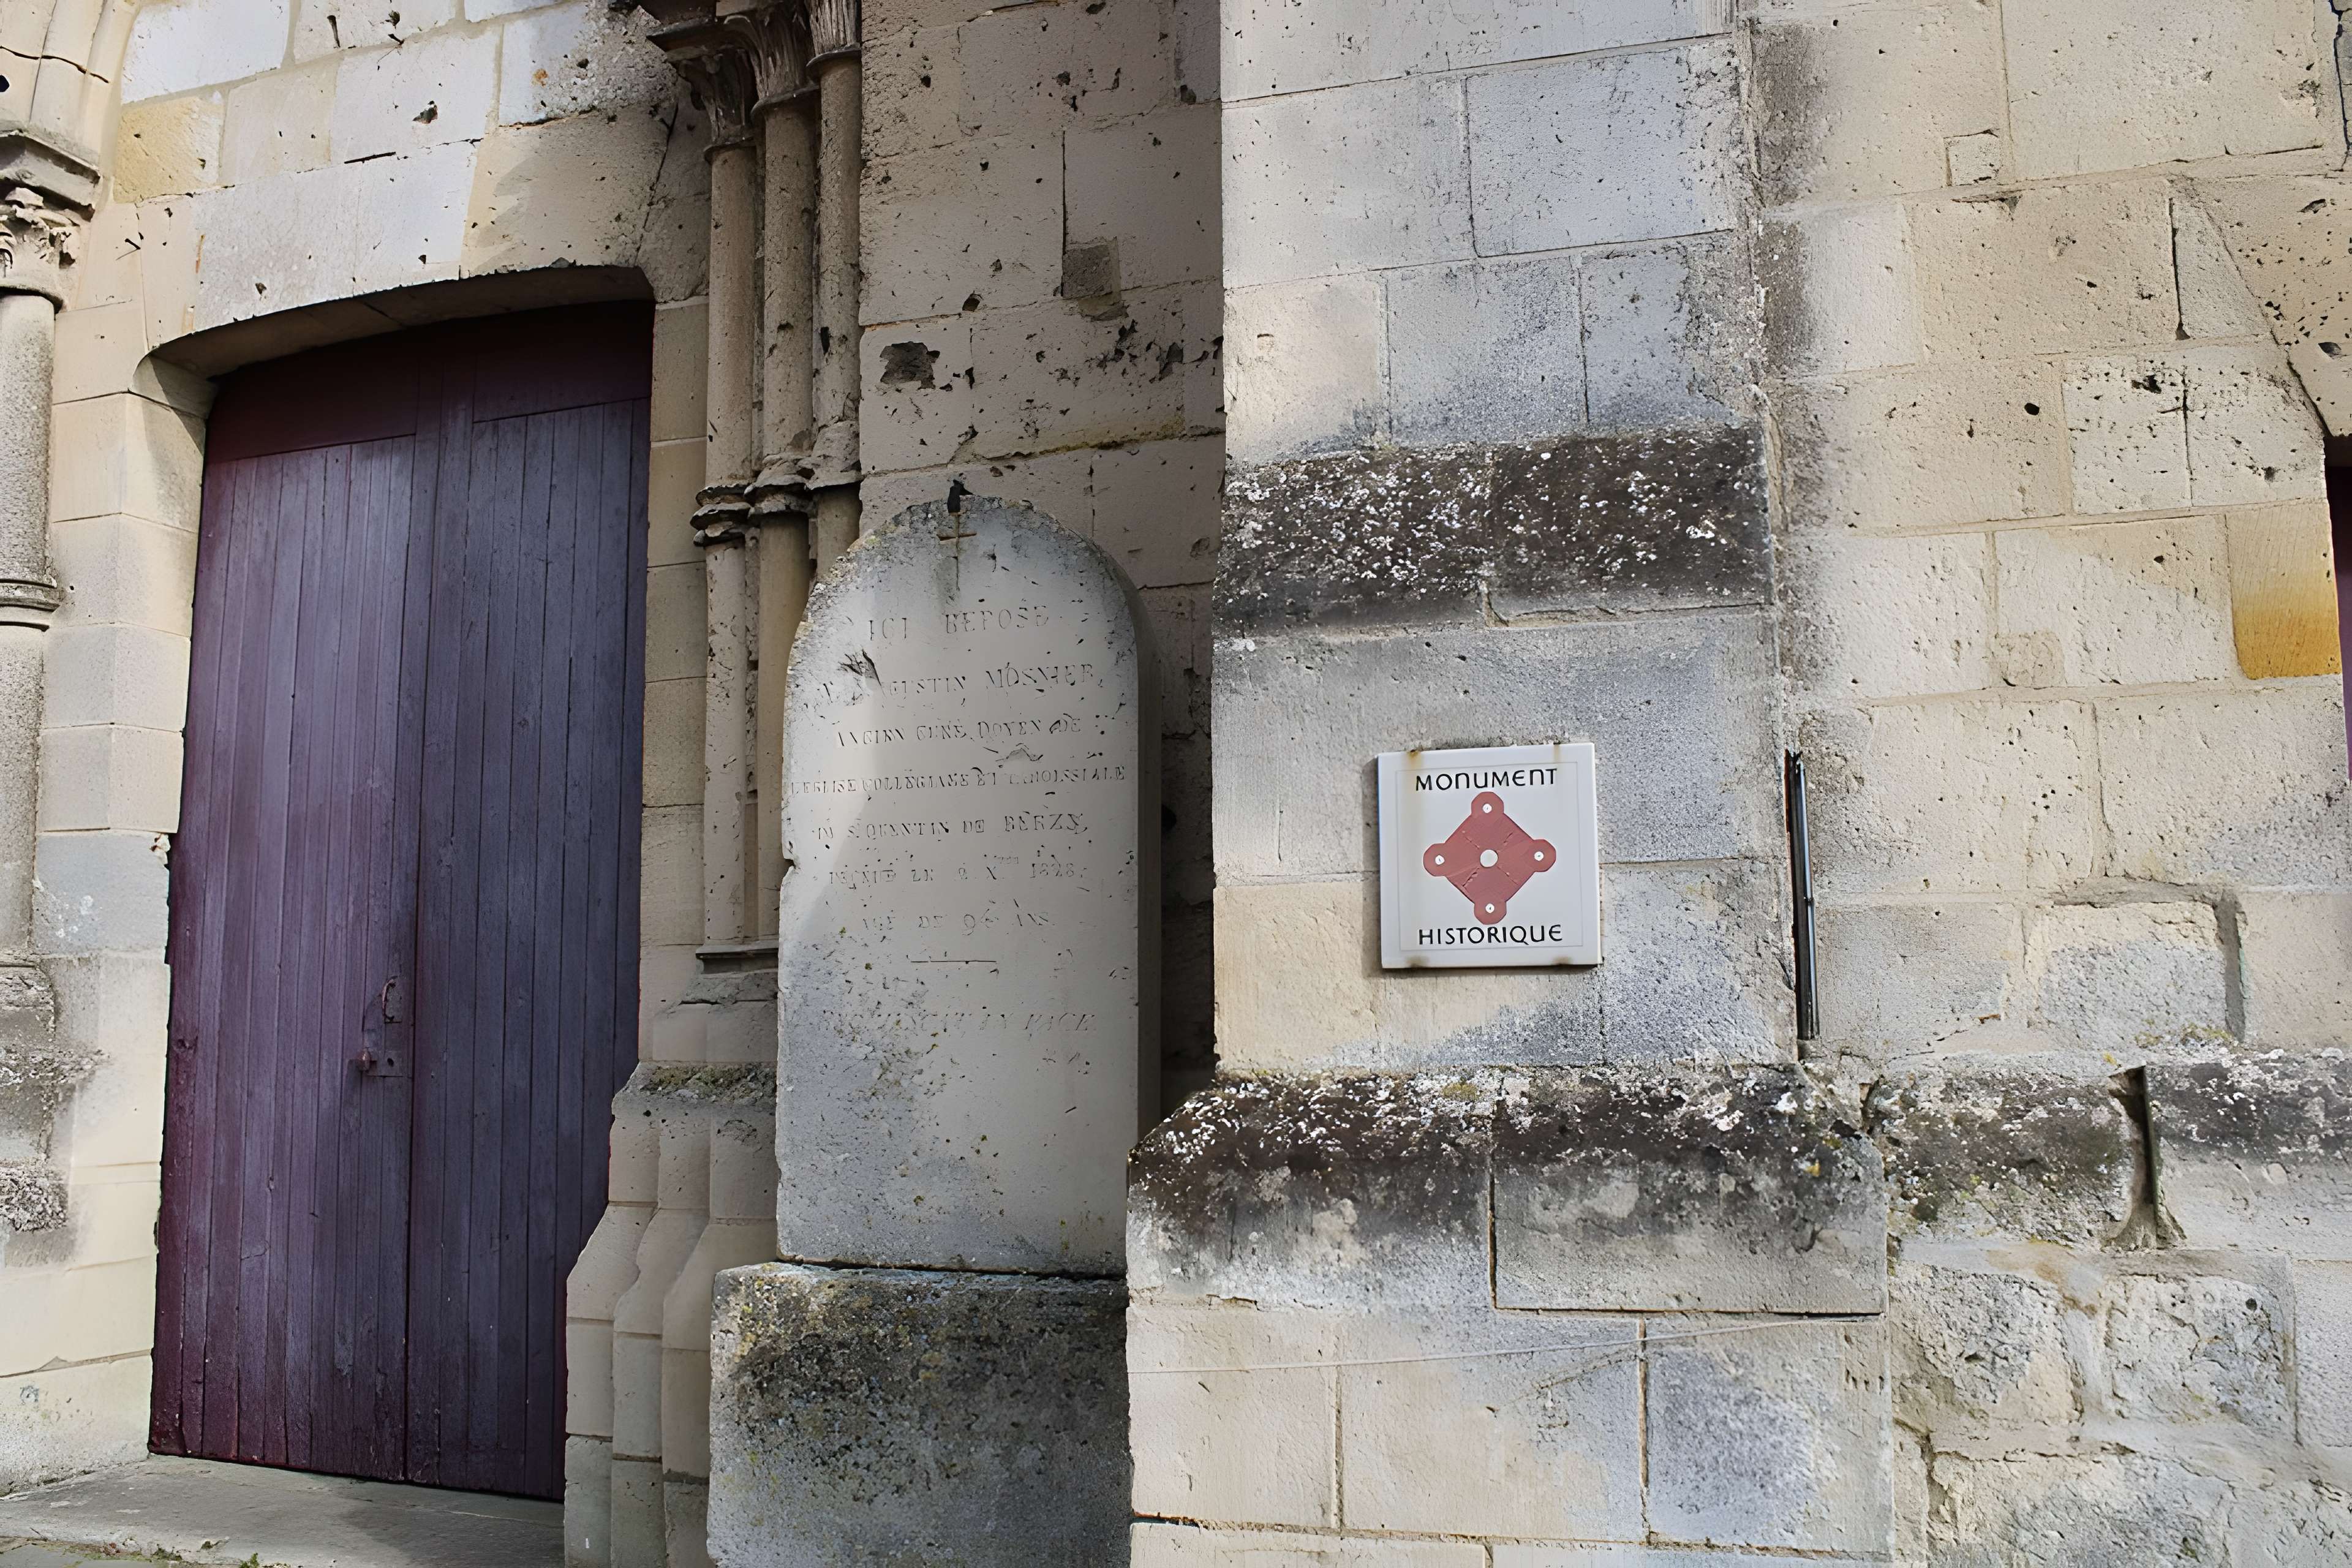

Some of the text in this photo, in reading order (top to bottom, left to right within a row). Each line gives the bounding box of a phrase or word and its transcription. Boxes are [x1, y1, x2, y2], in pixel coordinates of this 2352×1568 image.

[868, 616, 908, 641] ICI
[1415, 767, 1558, 791] MONUMENT
[1418, 924, 1563, 946] HISTORIQUE
